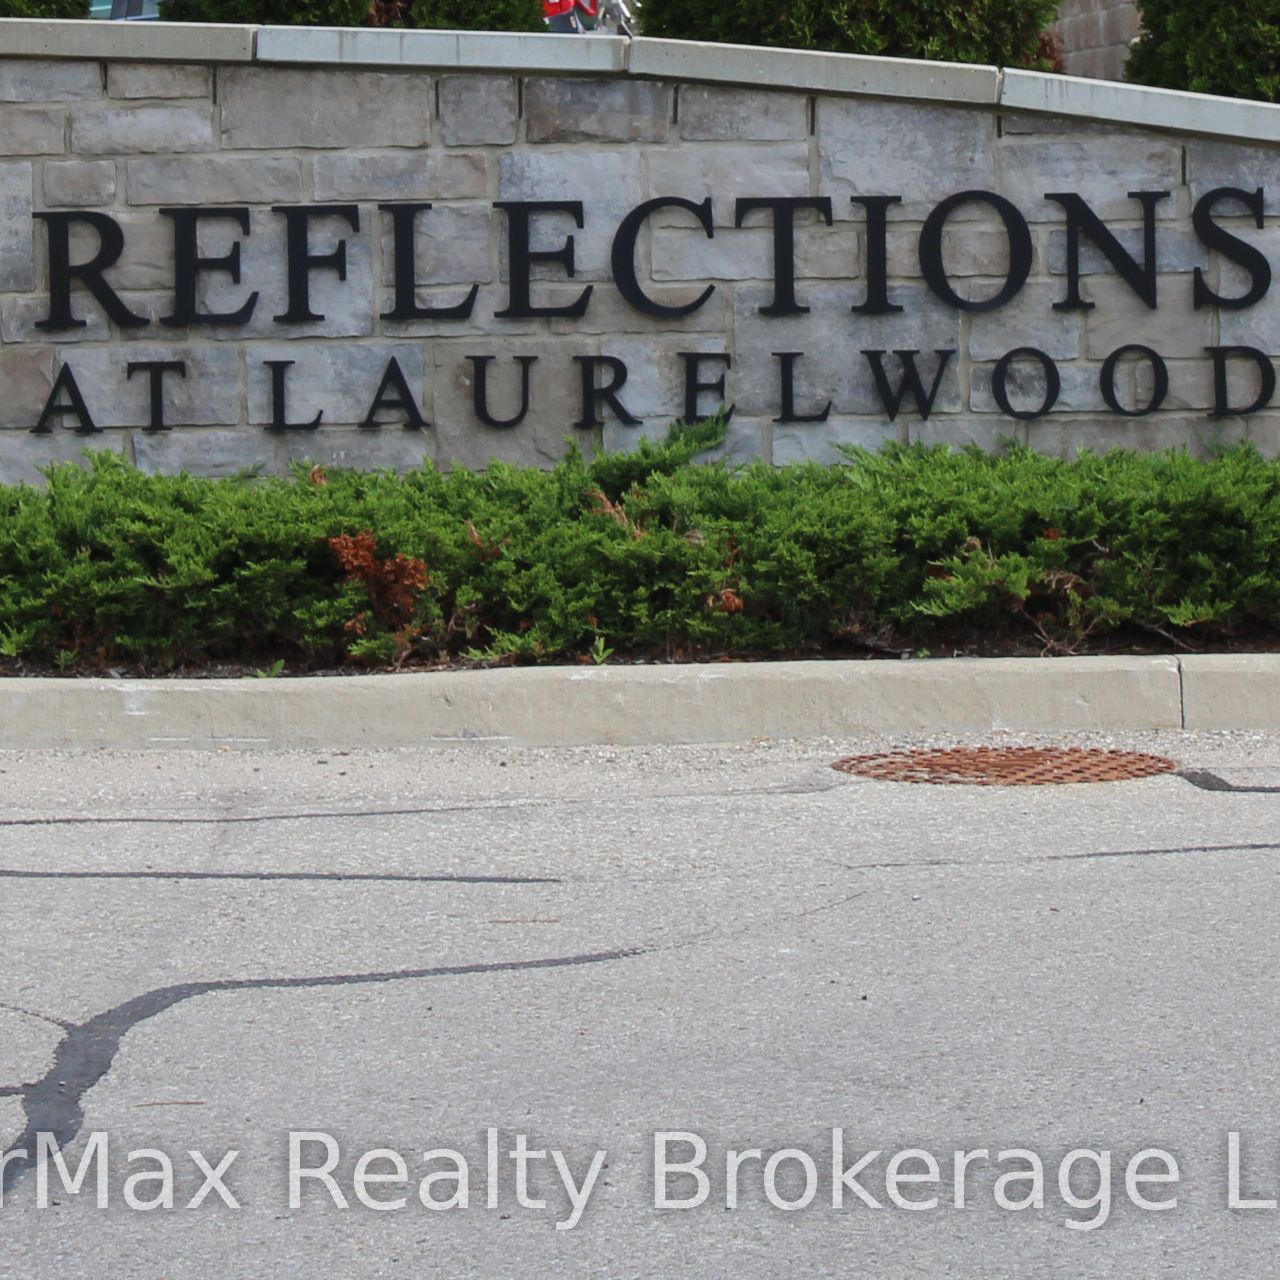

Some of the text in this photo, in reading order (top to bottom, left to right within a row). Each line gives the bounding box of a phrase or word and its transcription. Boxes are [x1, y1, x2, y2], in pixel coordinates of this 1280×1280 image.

[31, 186, 1273, 329] REFLECTIONS
[29, 343, 1277, 434] AT LAURELWOOD
